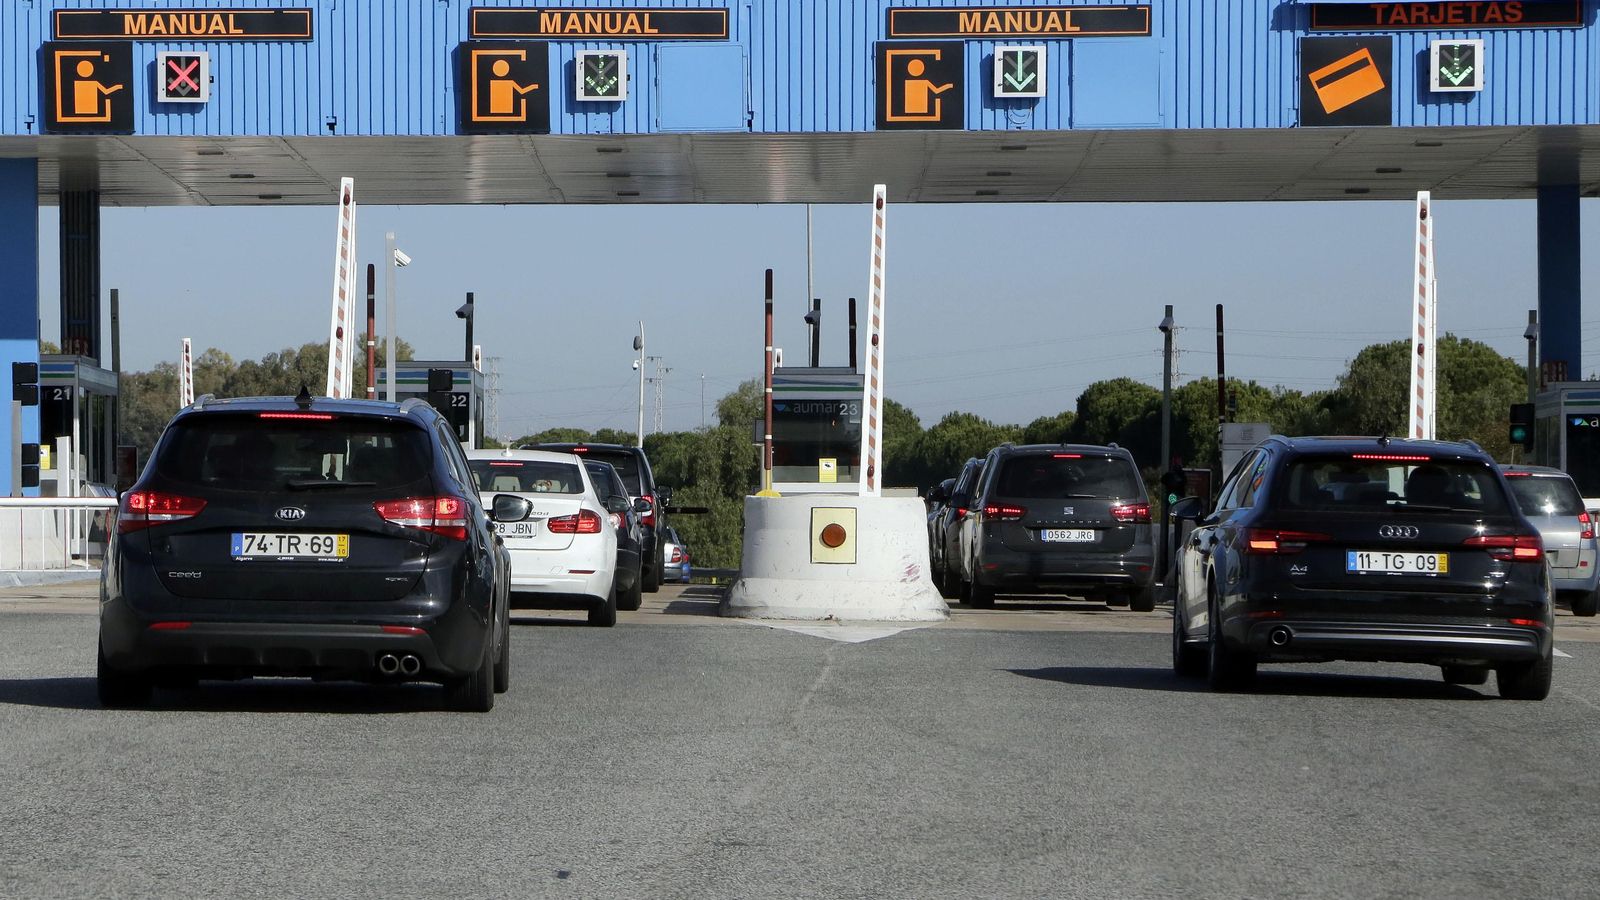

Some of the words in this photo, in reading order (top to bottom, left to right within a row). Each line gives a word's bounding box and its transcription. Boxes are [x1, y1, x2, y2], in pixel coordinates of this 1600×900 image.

[1370, 2, 1523, 25] TARJETAS
[124, 14, 243, 34] MANUAL
[540, 13, 658, 33] MANUAL
[959, 11, 1080, 32] MANUAL
[53, 388, 71, 400] 21
[793, 402, 838, 413] aumar
[840, 403, 858, 415] 23
[280, 509, 300, 519] KIA
[512, 523, 532, 534] JBN
[1048, 531, 1072, 539] 0562
[1075, 531, 1092, 539] JRG
